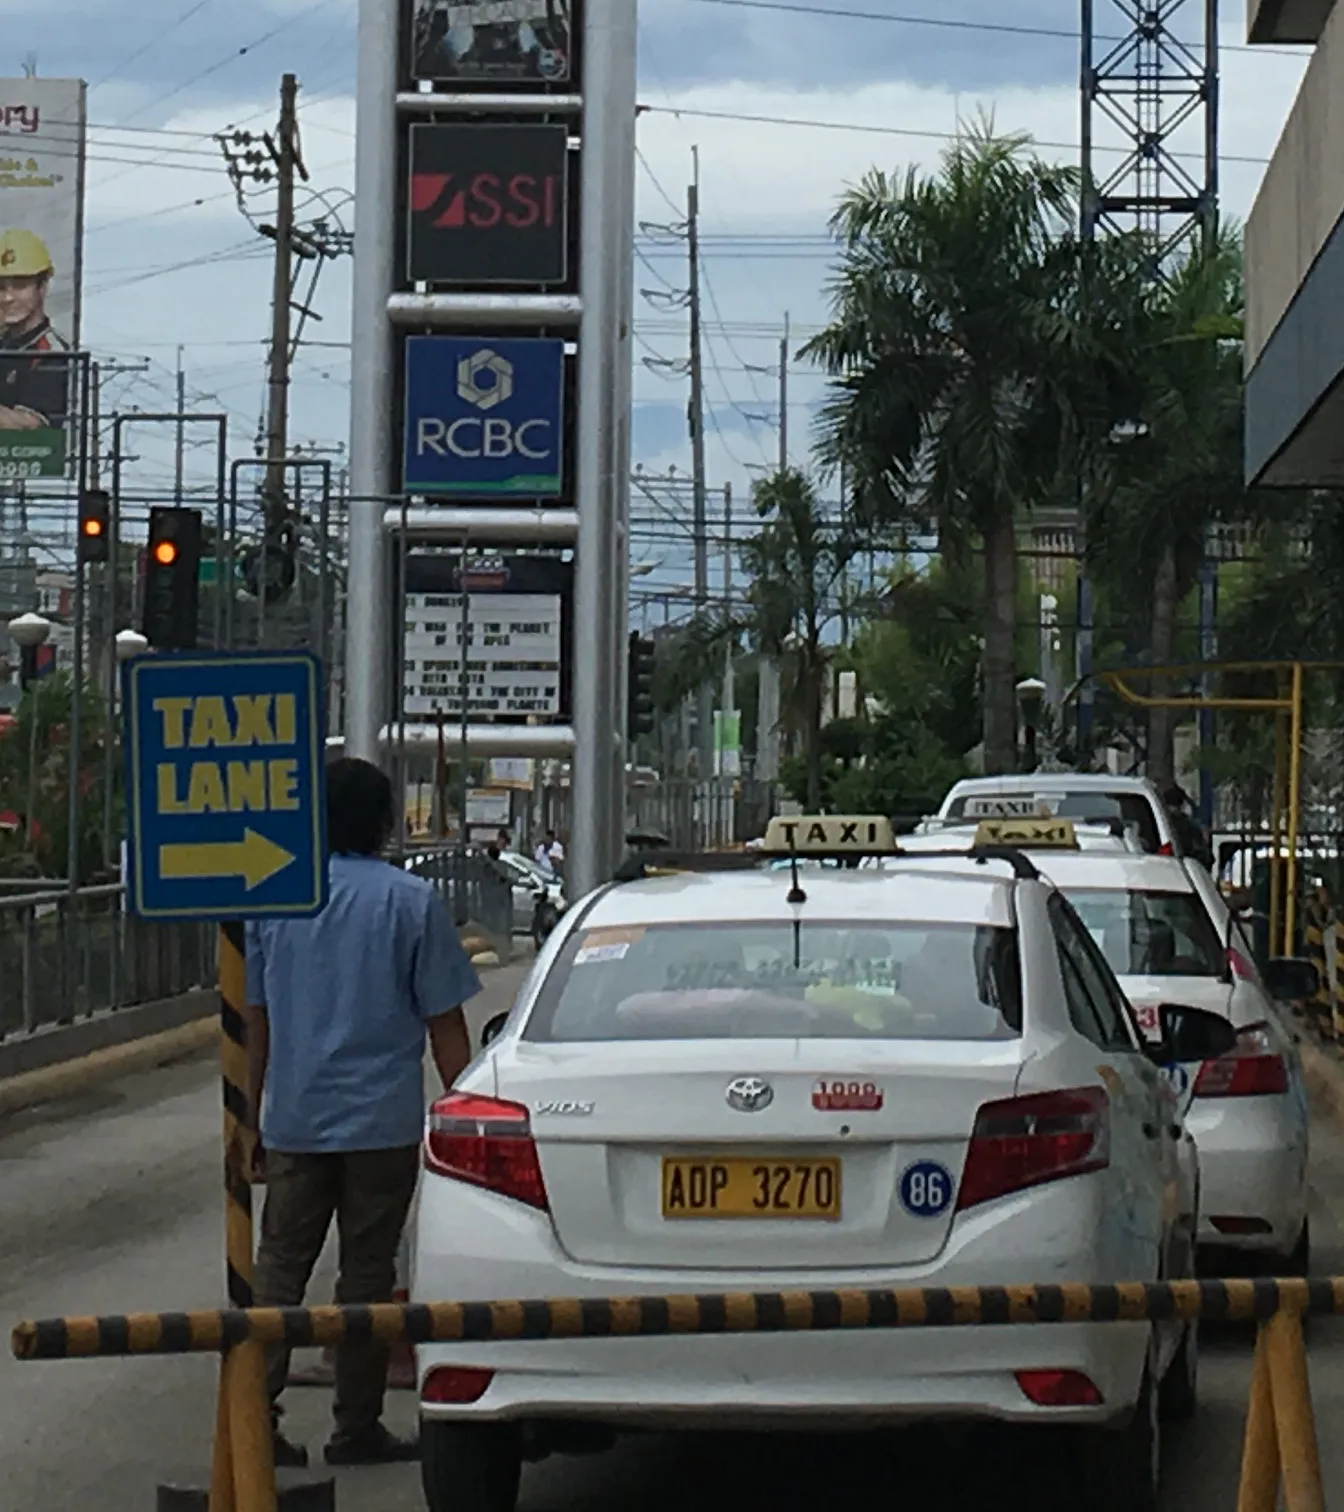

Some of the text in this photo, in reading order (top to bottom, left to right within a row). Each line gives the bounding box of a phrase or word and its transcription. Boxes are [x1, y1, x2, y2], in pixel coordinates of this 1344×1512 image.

[468, 173, 553, 227] SSI
[417, 417, 551, 459] RCBC
[152, 693, 297, 749] TAXI
[157, 758, 301, 815] LANE
[779, 823, 876, 843] TAXI
[752, 1165, 833, 1209] 3270
[909, 1172, 943, 1207] 86
